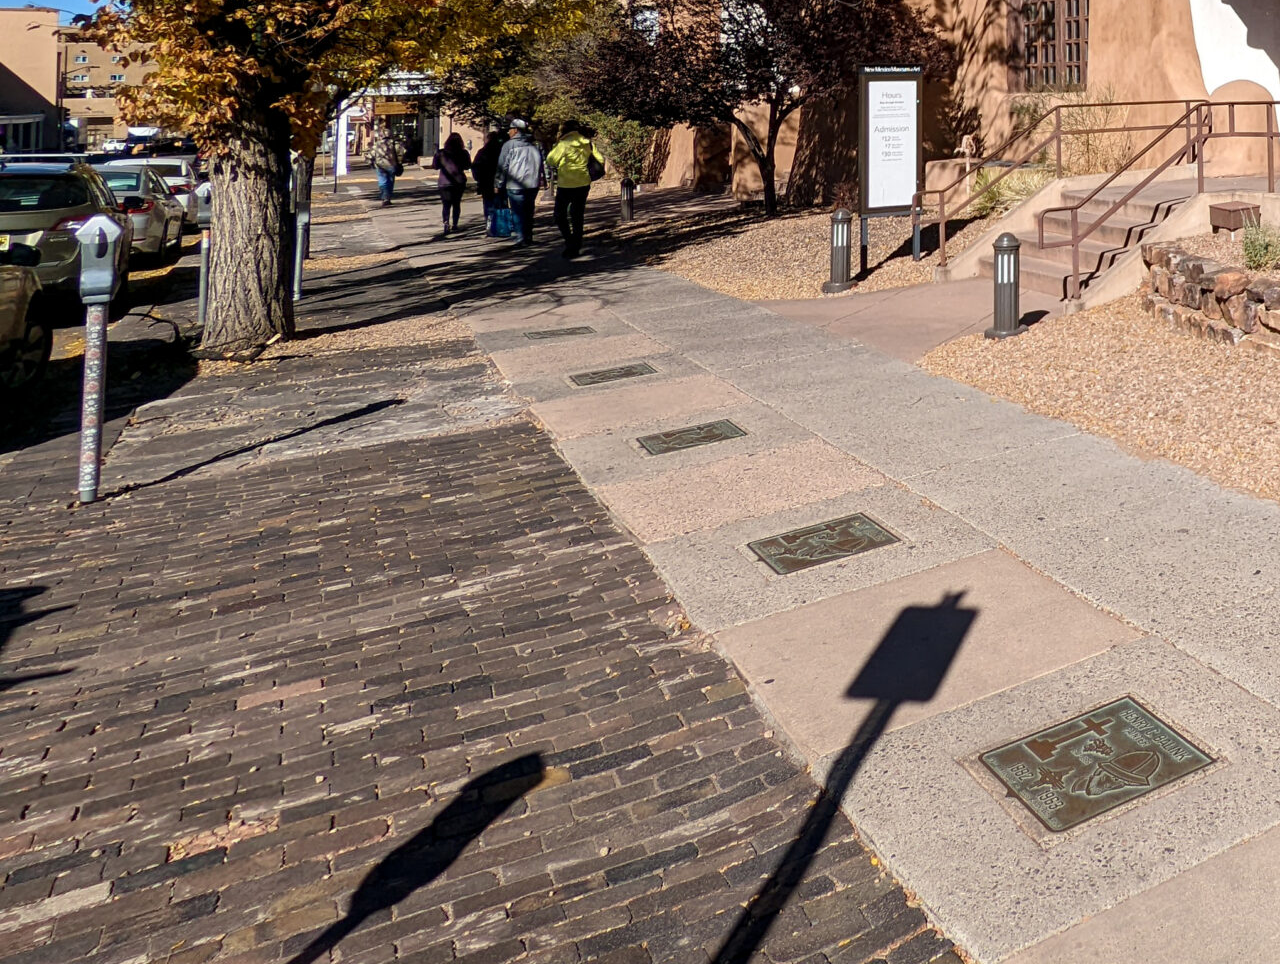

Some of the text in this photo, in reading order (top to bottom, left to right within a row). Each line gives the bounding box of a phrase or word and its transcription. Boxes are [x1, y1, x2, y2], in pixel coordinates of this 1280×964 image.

[882, 91, 902, 99] Hours
[874, 125, 910, 133] Admission
[1120, 709, 1152, 731] HENRY
[1152, 734, 1191, 761] BALINK
